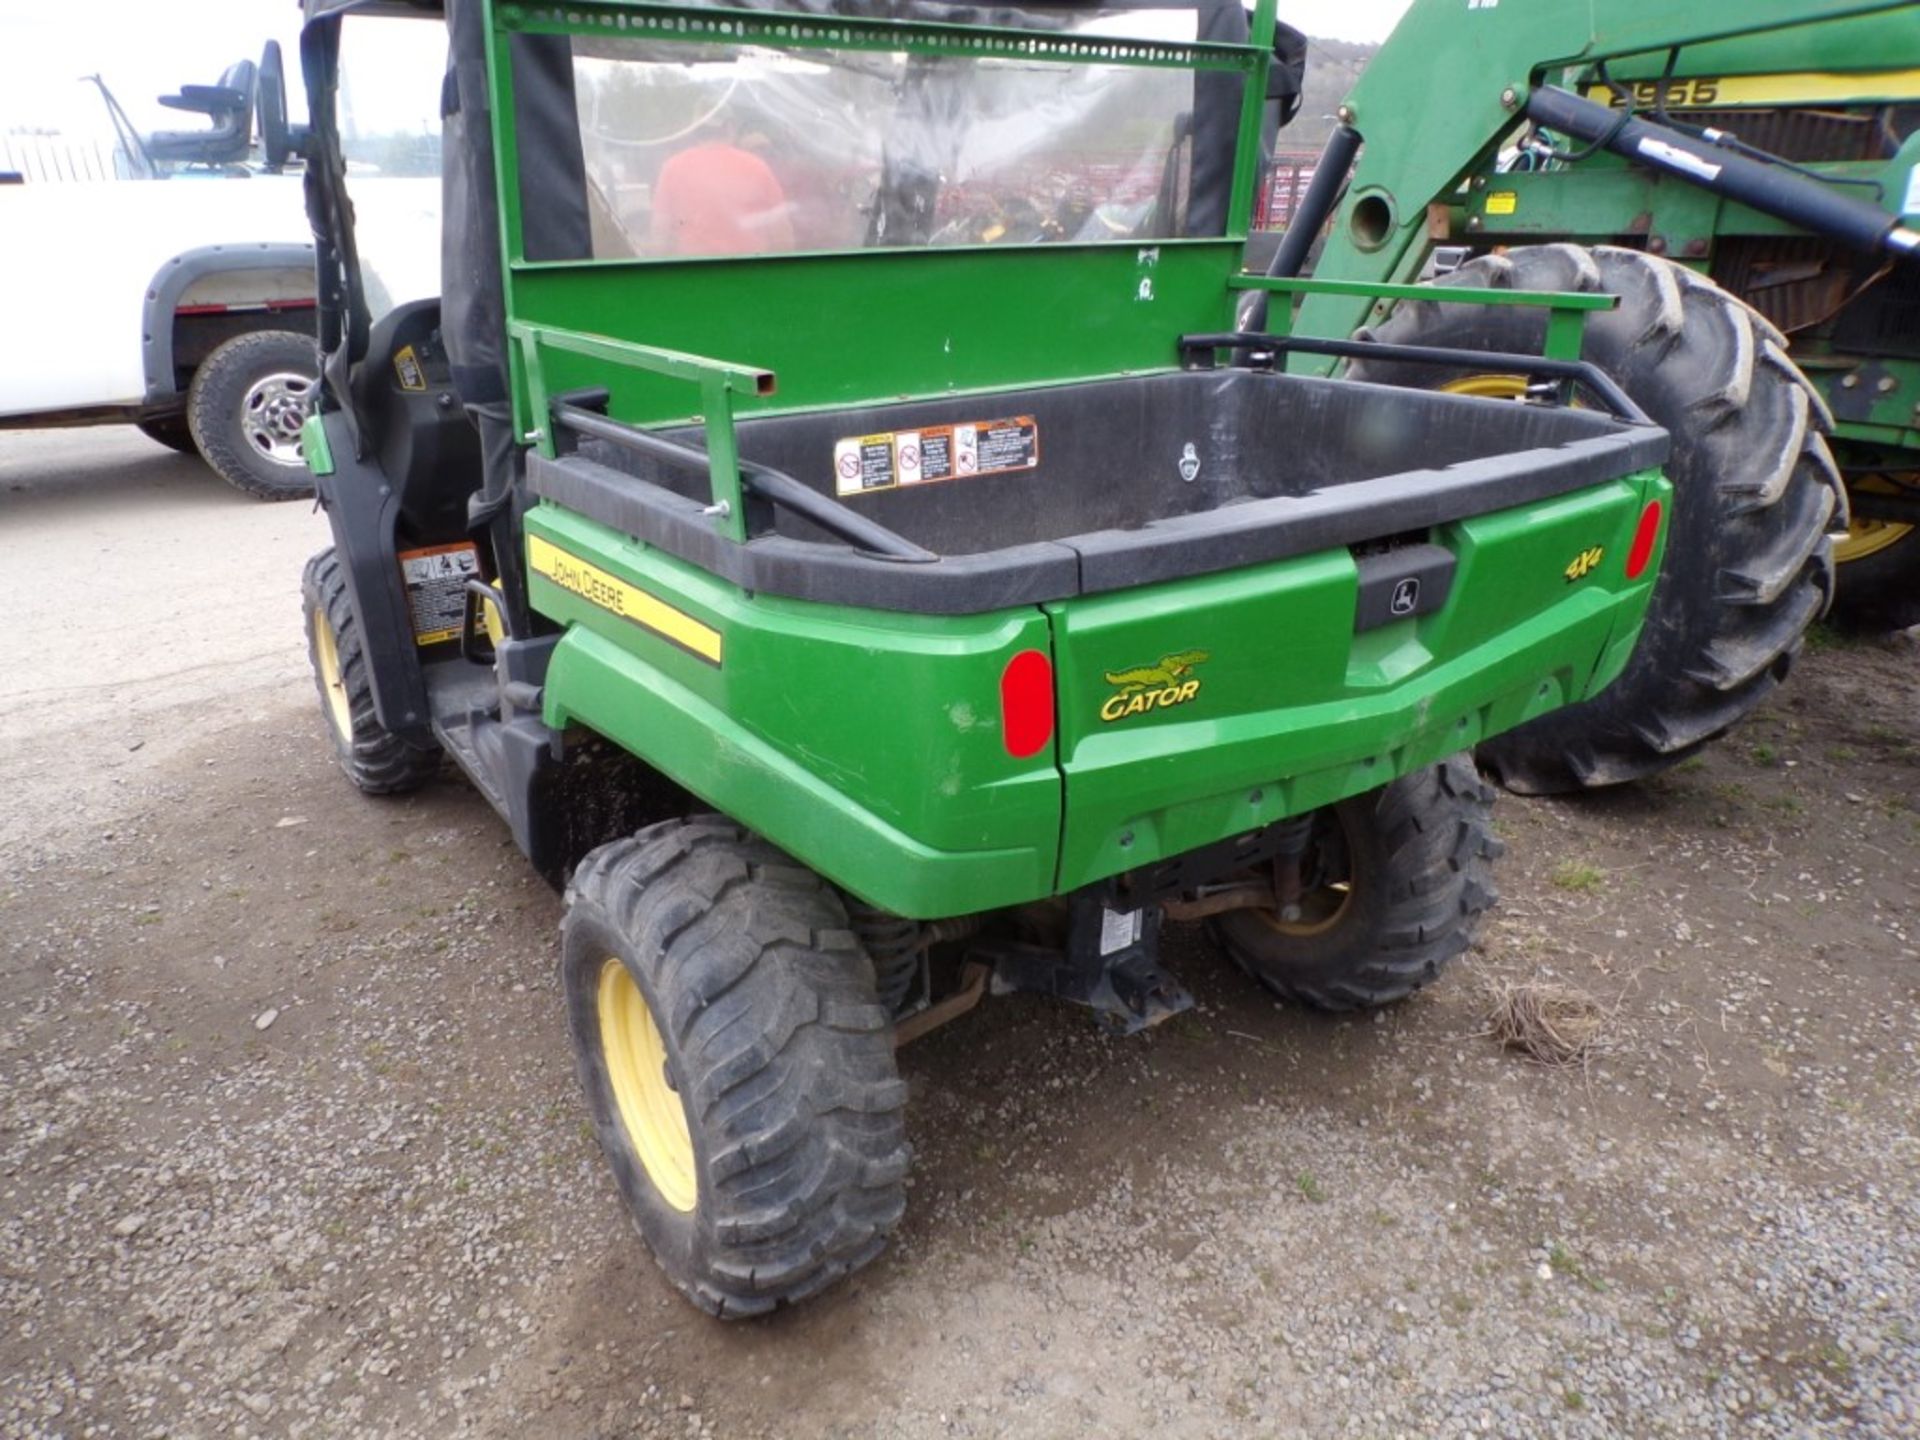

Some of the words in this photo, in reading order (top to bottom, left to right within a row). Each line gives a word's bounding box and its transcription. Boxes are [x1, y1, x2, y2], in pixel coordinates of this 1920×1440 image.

[551, 555, 581, 590] JOHN
[582, 569, 624, 612] DEERE
[1100, 679, 1200, 721] GATOR
